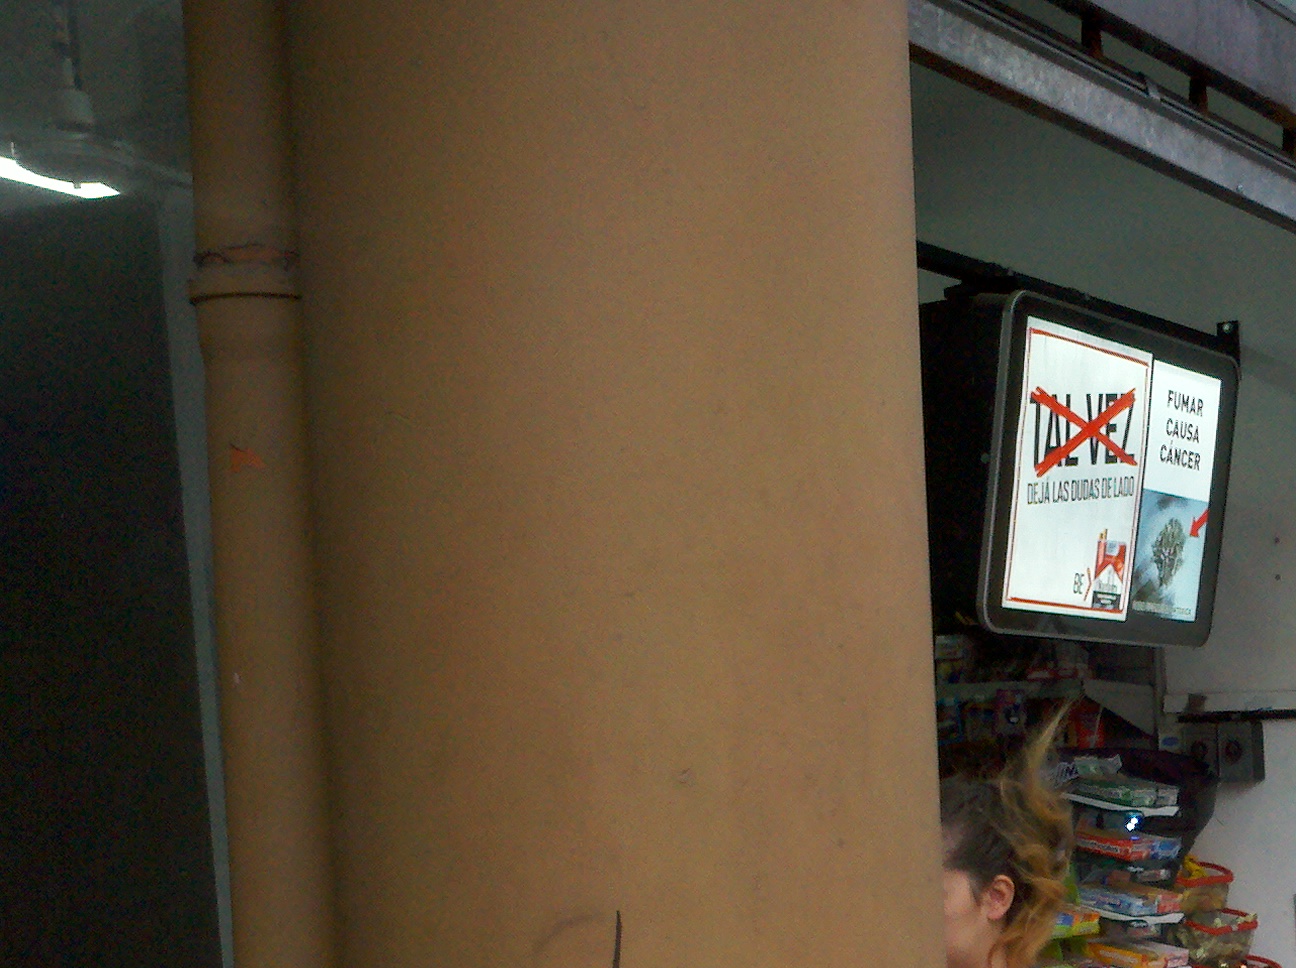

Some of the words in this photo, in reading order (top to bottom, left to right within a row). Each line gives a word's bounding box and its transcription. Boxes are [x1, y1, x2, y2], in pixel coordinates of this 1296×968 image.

[1167, 389, 1204, 417] FUMAR
[1165, 418, 1200, 444] CAUSA
[1159, 440, 1201, 471] CÁNCER
[1052, 481, 1070, 503] LAS
[1071, 478, 1100, 502] DUDAS
[1101, 478, 1113, 499] DE
[1113, 475, 1135, 498] LADO
